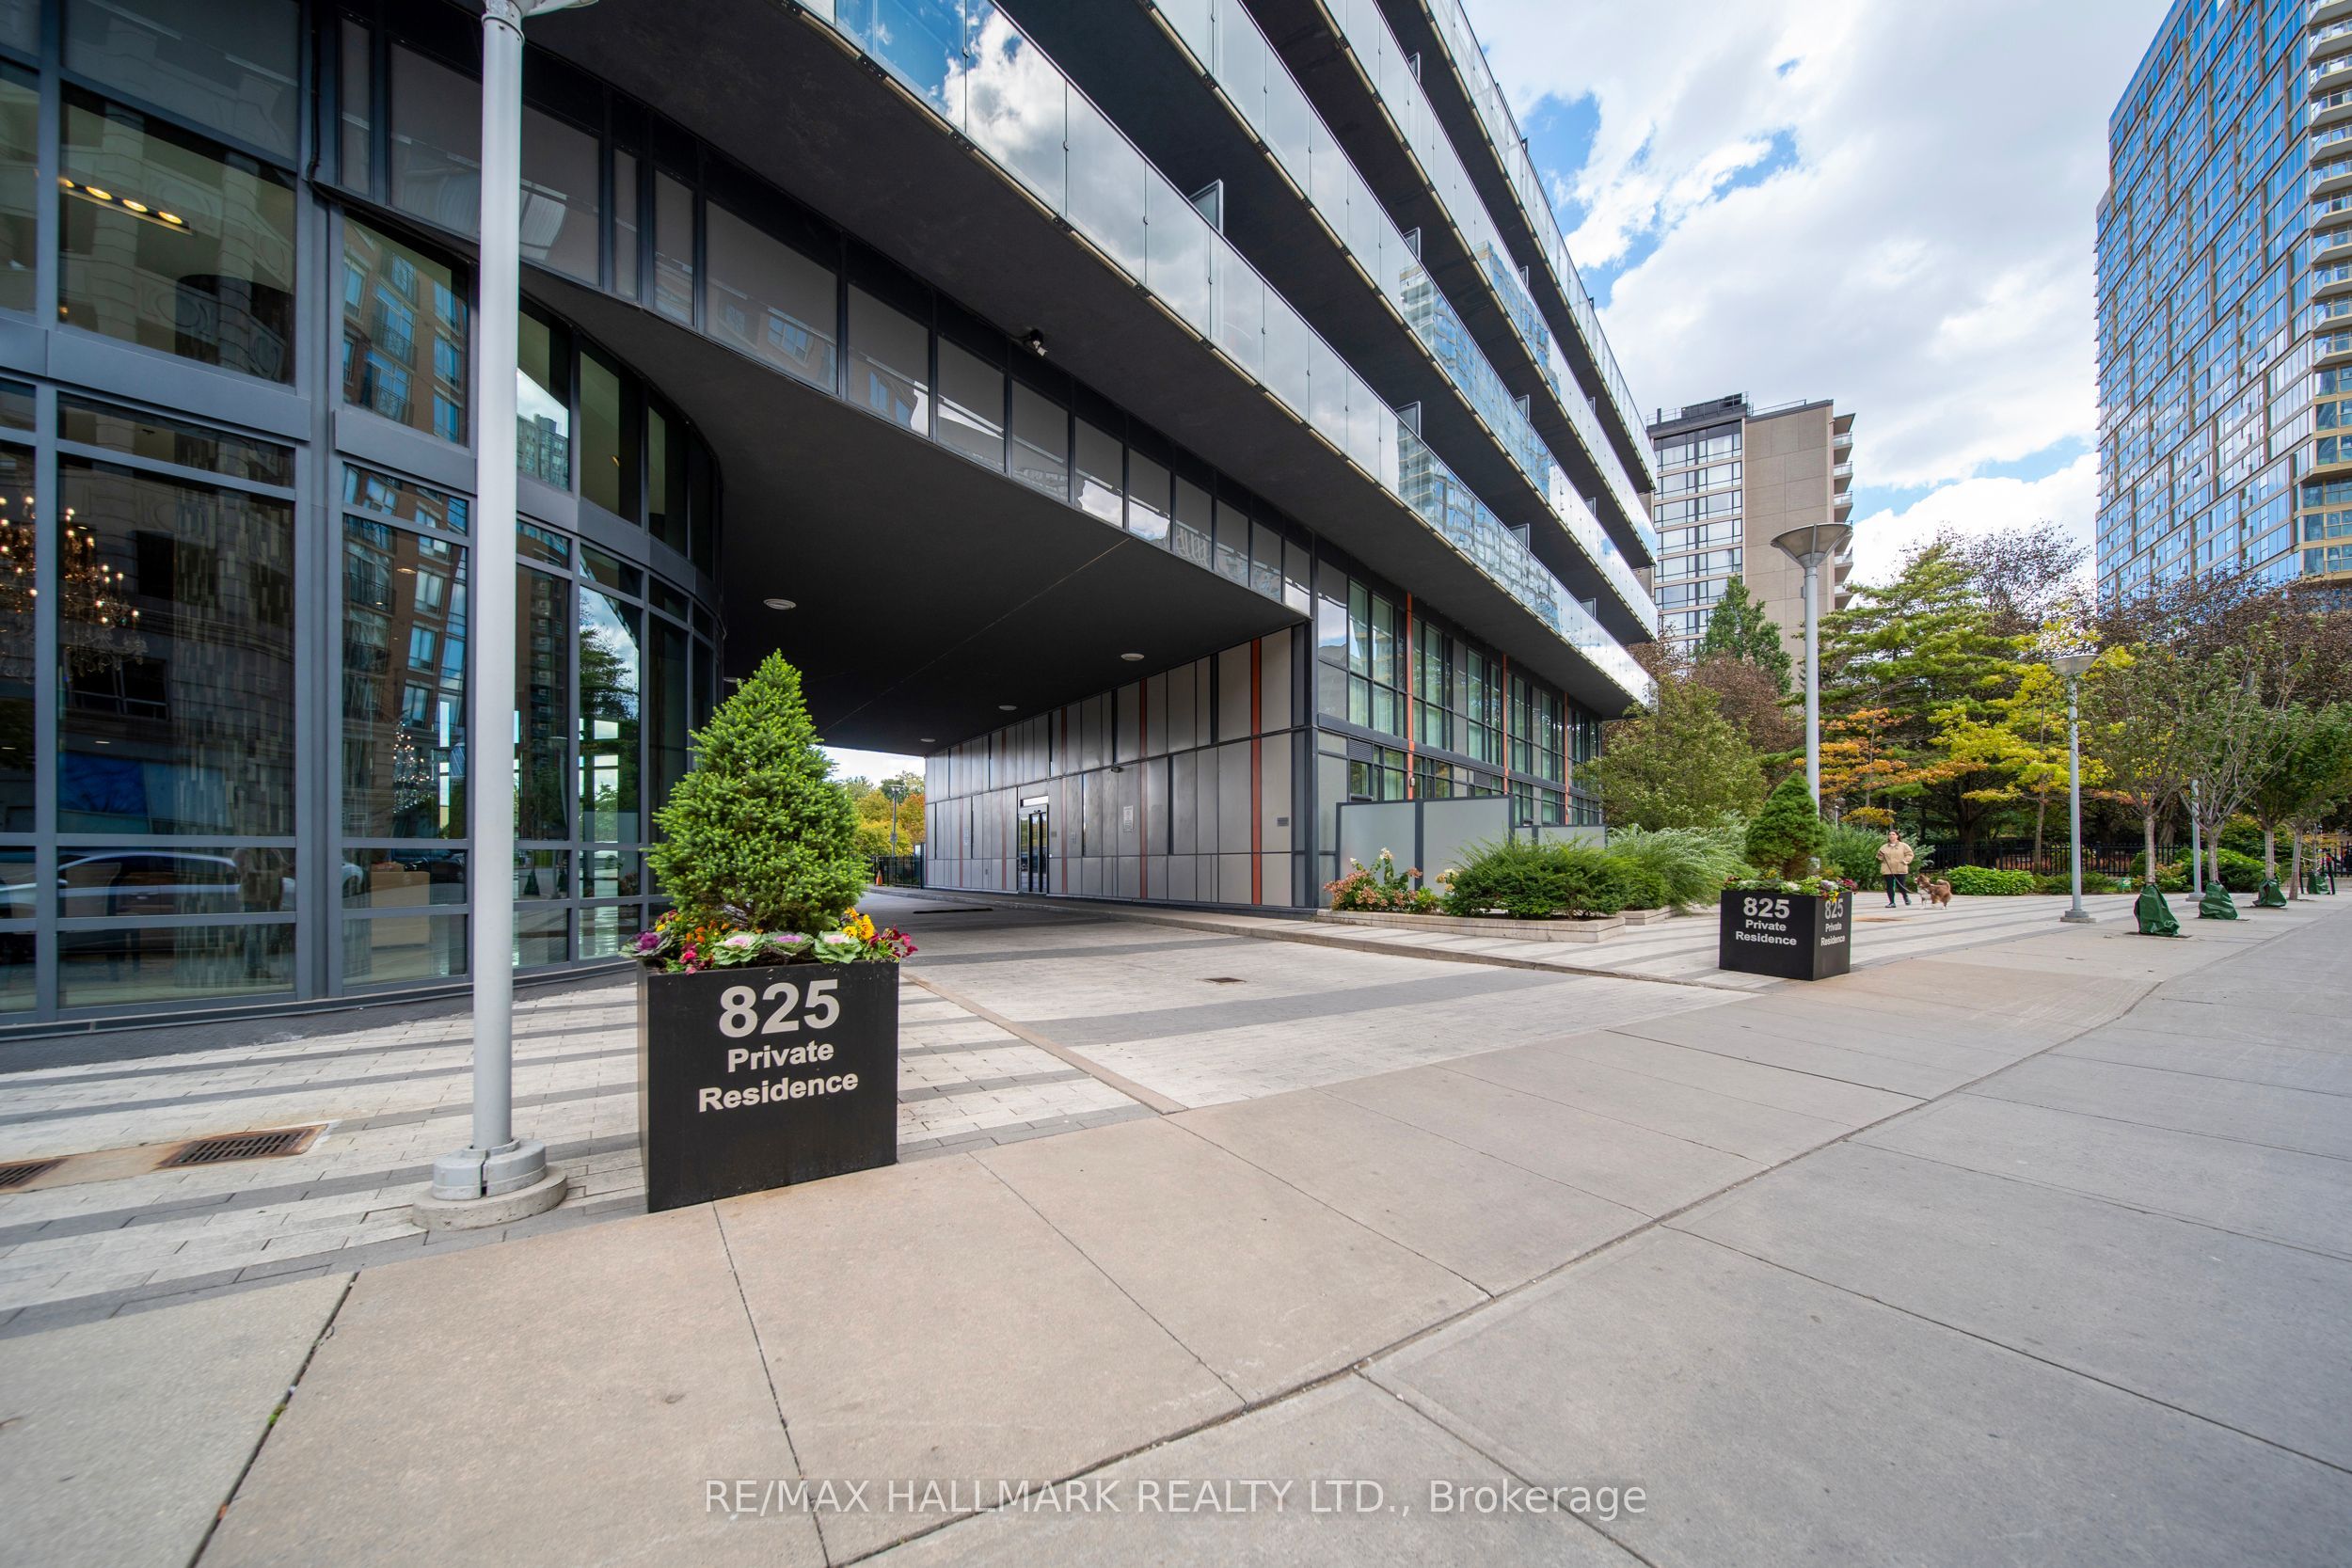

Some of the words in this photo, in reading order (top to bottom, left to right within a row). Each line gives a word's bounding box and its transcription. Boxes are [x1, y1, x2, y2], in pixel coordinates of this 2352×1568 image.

[1742, 896, 1790, 919] 825
[1825, 898, 1844, 920] 825
[1745, 919, 1787, 931] Private
[1825, 922, 1843, 932] Private
[1735, 930, 1797, 946] Residence
[1820, 935, 1846, 946] Residence
[718, 978, 840, 1038] 825
[727, 1039, 834, 1073] Private
[698, 1071, 859, 1113] Residence
